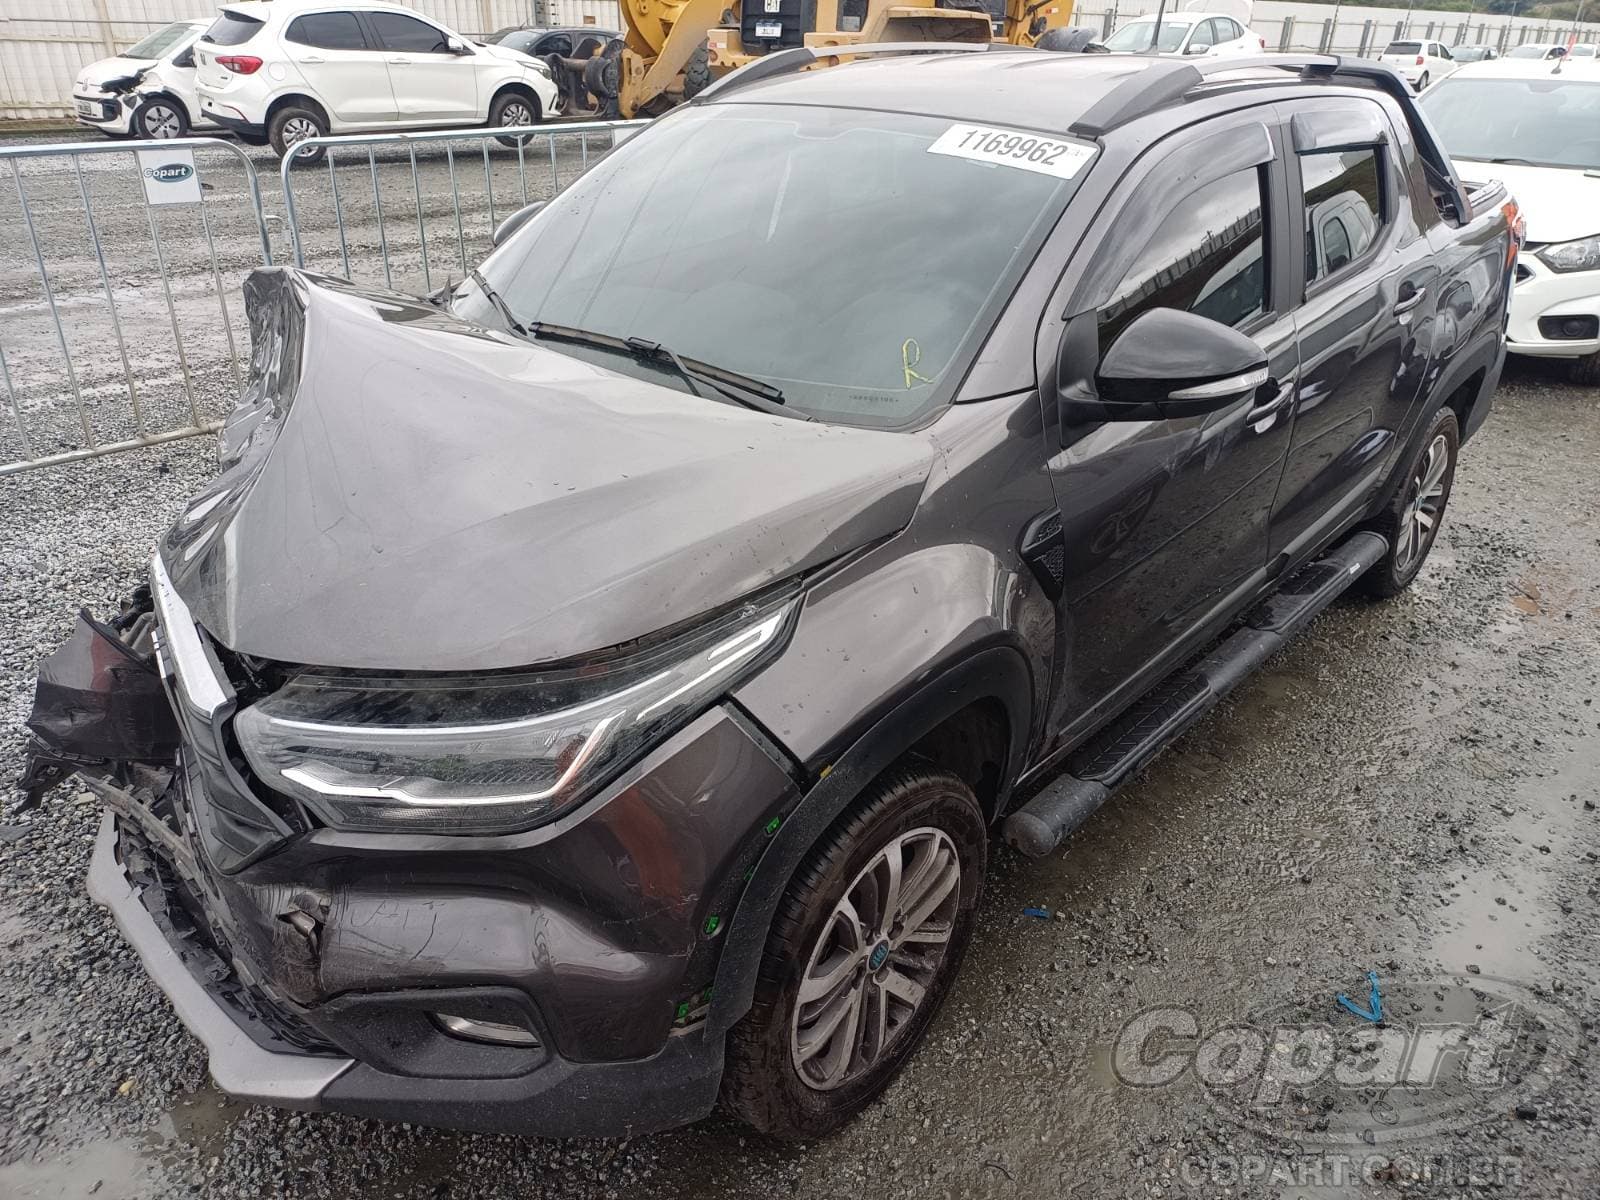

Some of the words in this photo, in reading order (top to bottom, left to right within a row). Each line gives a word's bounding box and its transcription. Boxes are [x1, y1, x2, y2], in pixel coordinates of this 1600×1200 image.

[957, 129, 1069, 166] 1169962
[143, 166, 187, 179] Copart
[902, 338, 934, 390] R
